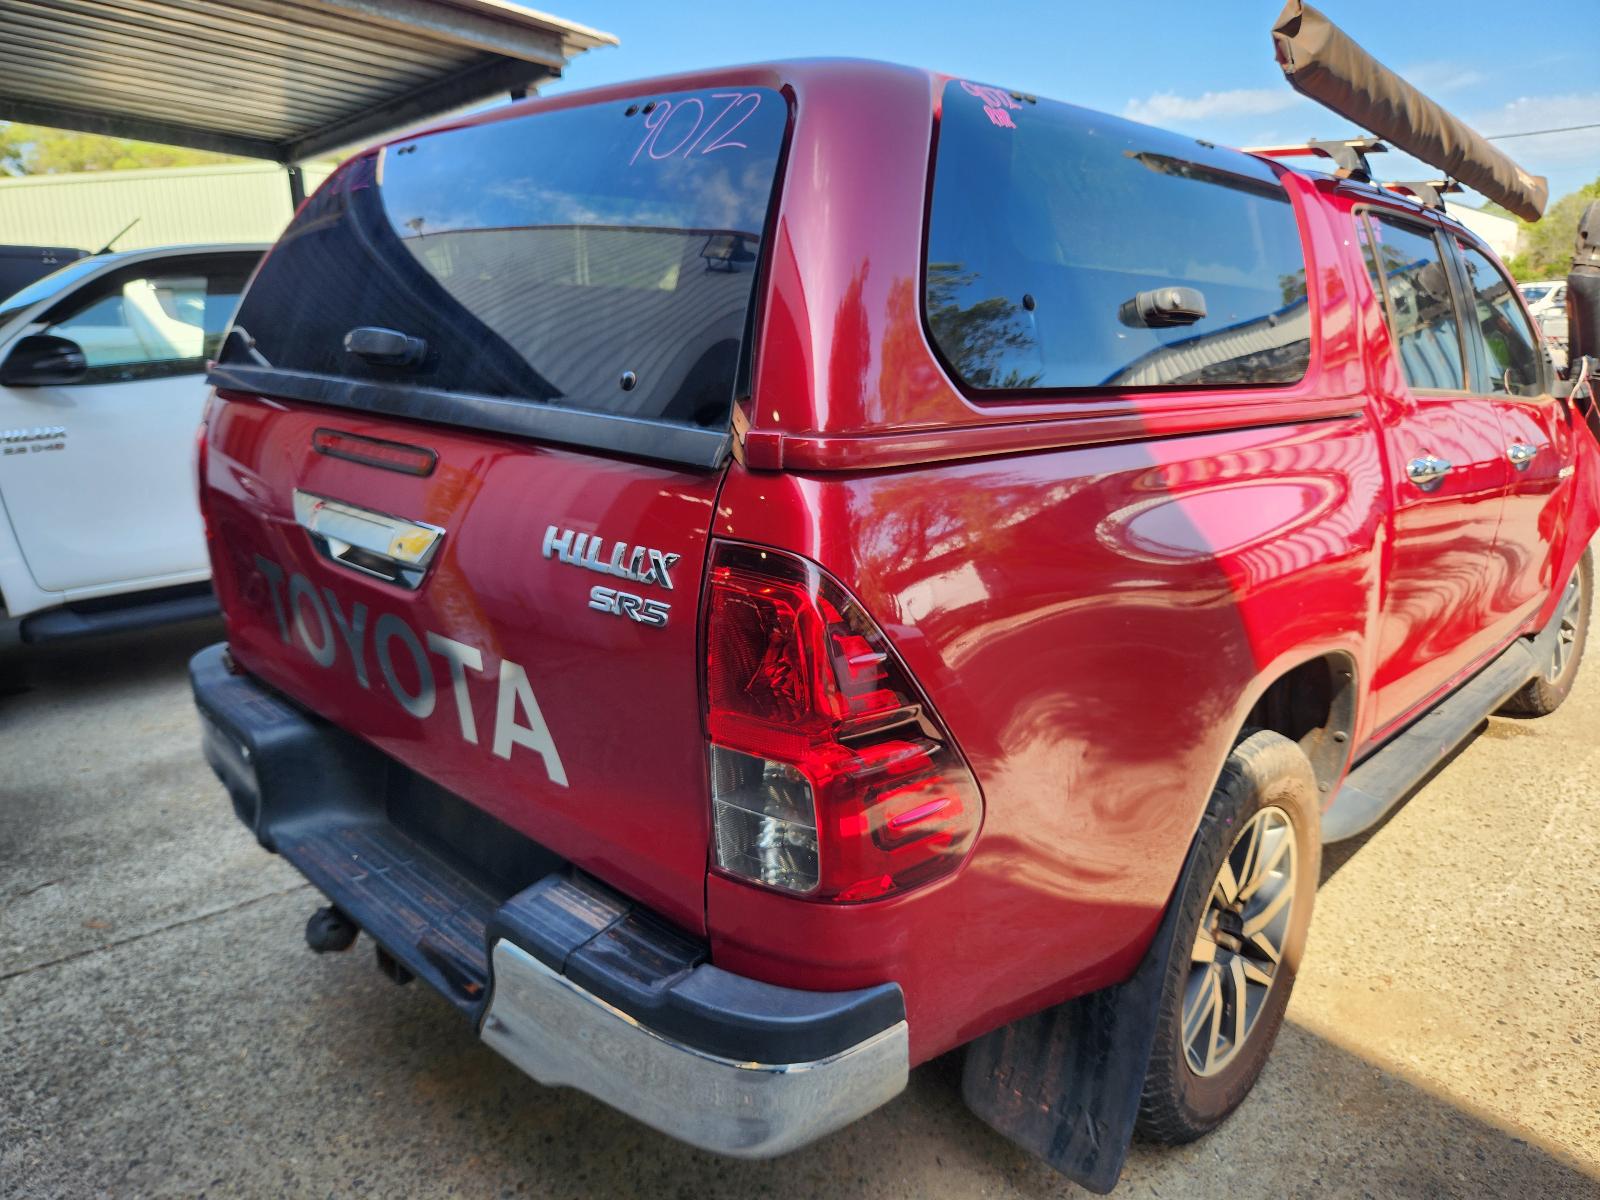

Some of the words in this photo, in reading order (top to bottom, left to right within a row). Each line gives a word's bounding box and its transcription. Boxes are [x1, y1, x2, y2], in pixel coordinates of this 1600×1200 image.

[630, 92, 761, 166] 9072
[542, 525, 681, 590] HILUX
[588, 585, 671, 628] SR5
[255, 555, 569, 788] TOYOTA
